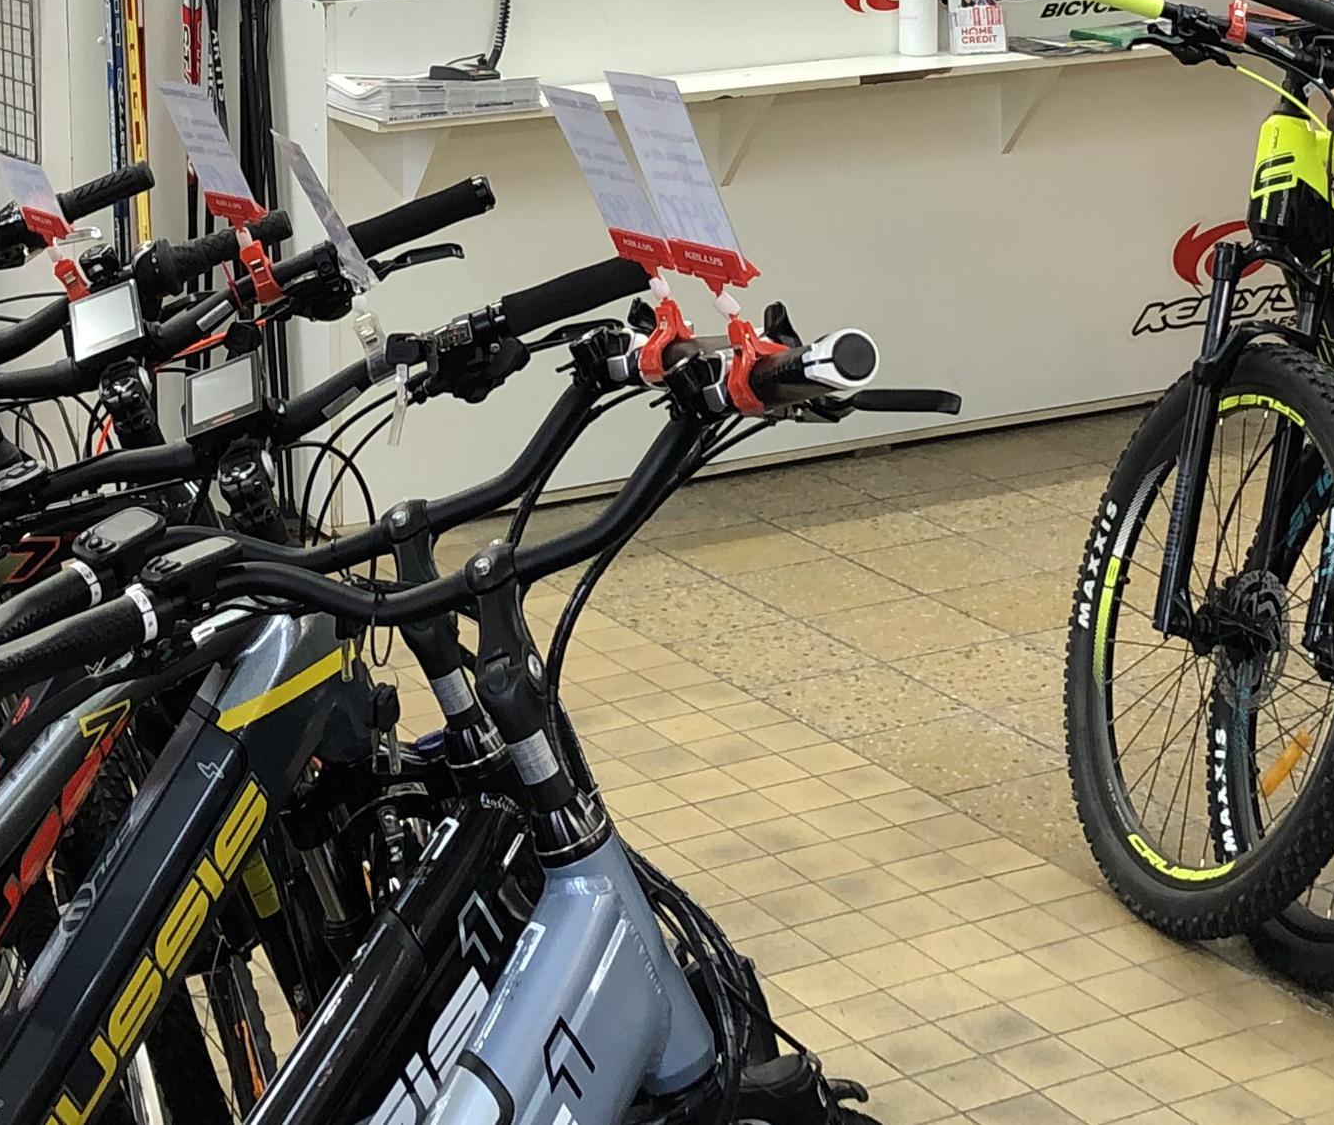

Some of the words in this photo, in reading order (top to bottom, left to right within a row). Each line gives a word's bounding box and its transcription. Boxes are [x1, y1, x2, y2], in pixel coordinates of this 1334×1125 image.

[961, 27, 994, 36] HOME
[961, 34, 998, 45] CREDIT
[683, 250, 724, 267] KELLYS
[1078, 499, 1117, 630] MAXXIS
[1215, 728, 1238, 852] MAXXIS
[1127, 832, 1236, 882] CRUSSIS
